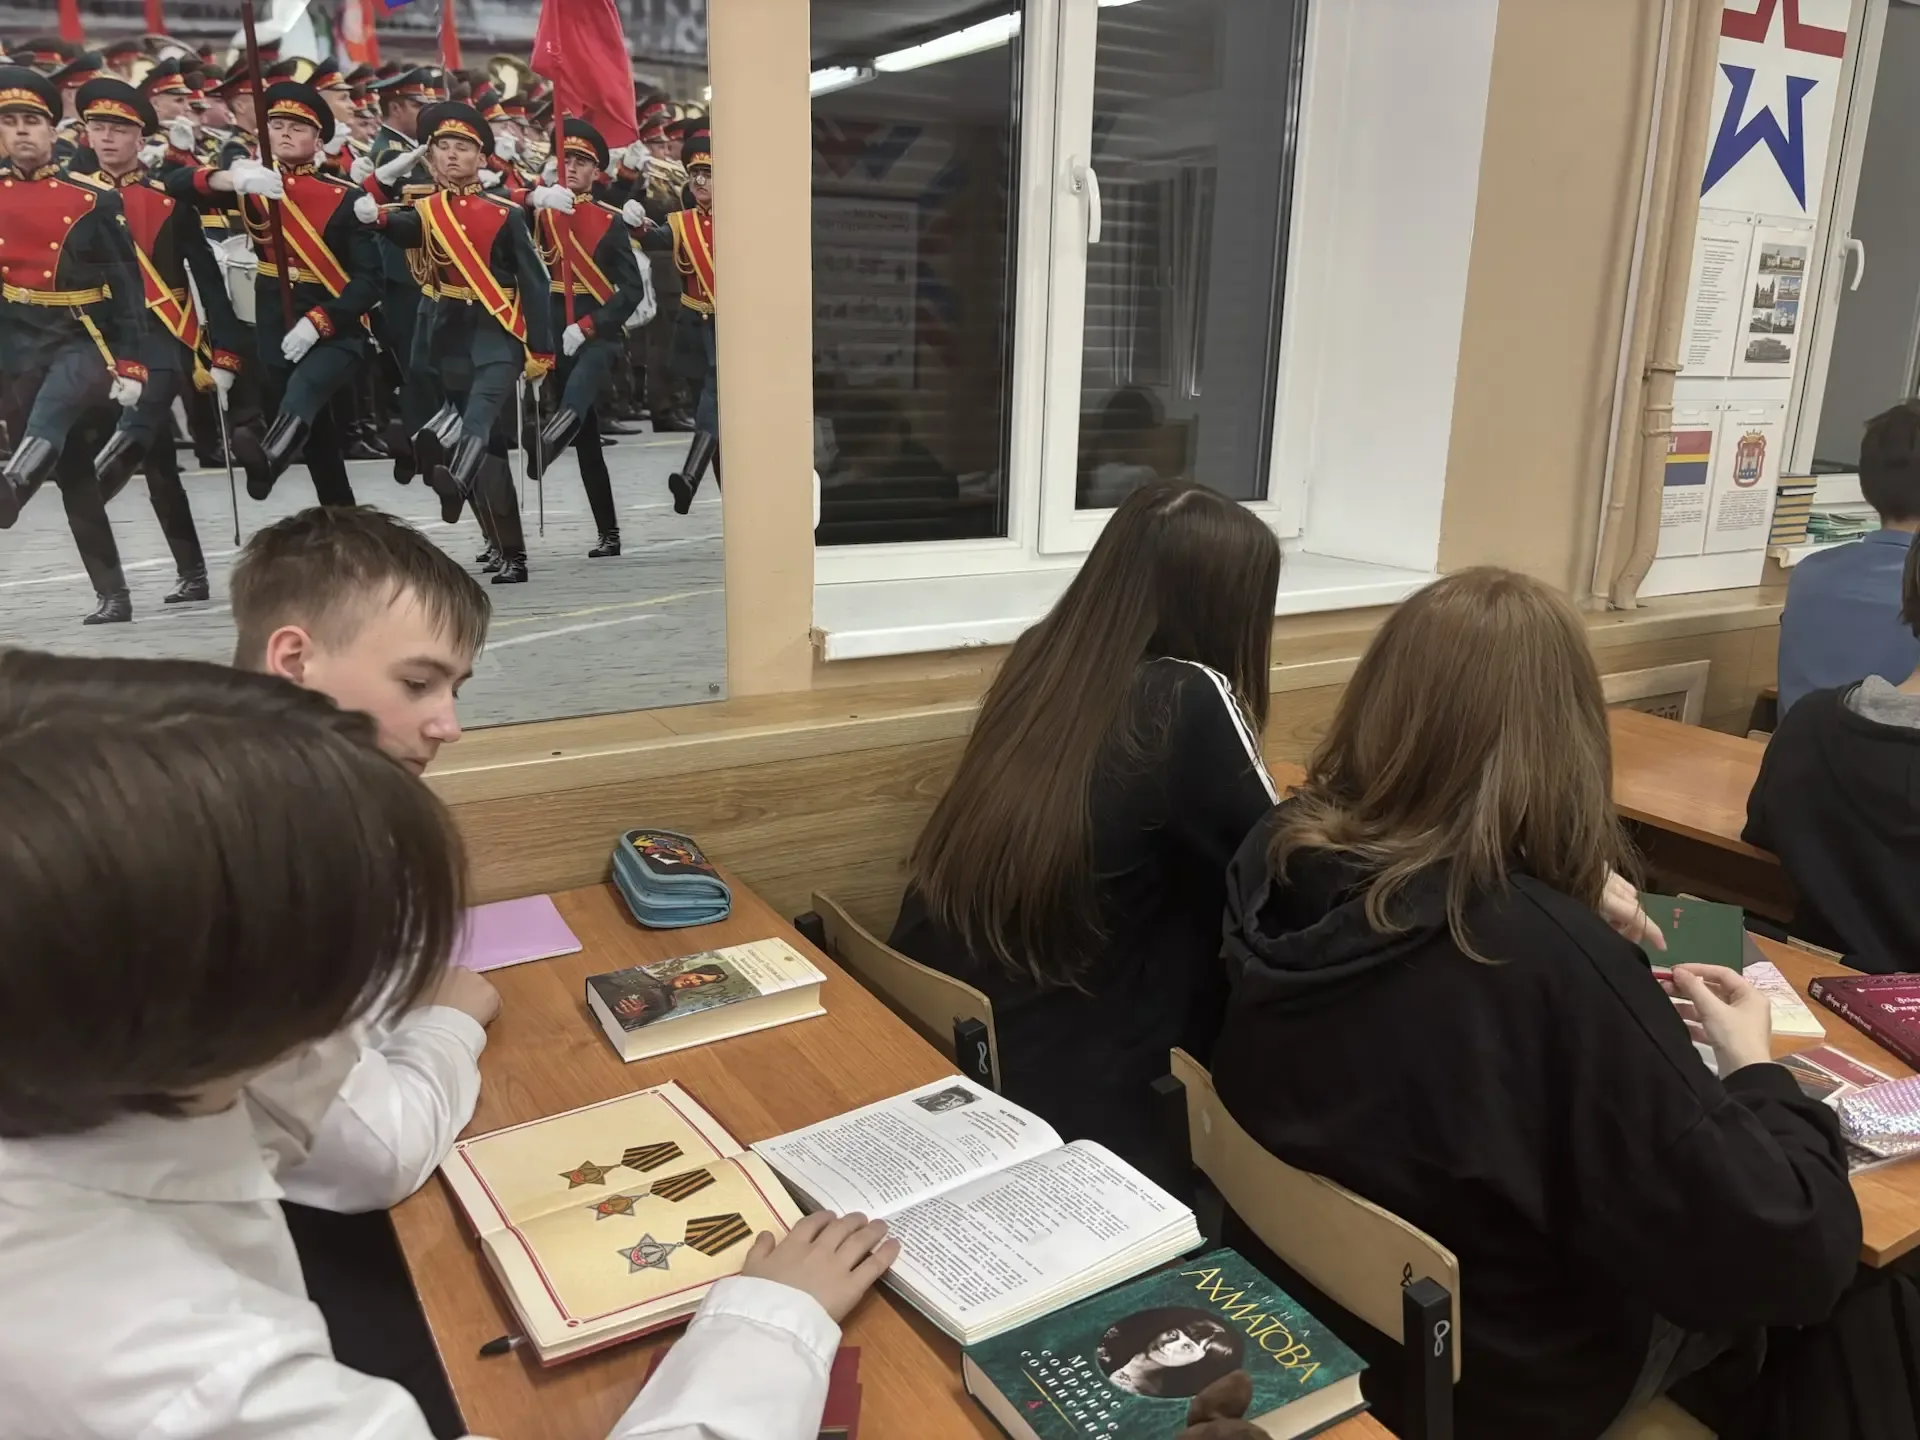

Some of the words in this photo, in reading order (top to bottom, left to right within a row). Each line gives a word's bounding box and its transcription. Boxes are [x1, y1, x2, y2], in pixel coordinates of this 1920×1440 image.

[1180, 1268, 1321, 1384] АХМАТОВА
[1434, 1319, 1450, 1357] 8
[1041, 1350, 1119, 1430] собрание
[1068, 1354, 1121, 1410] Малое
